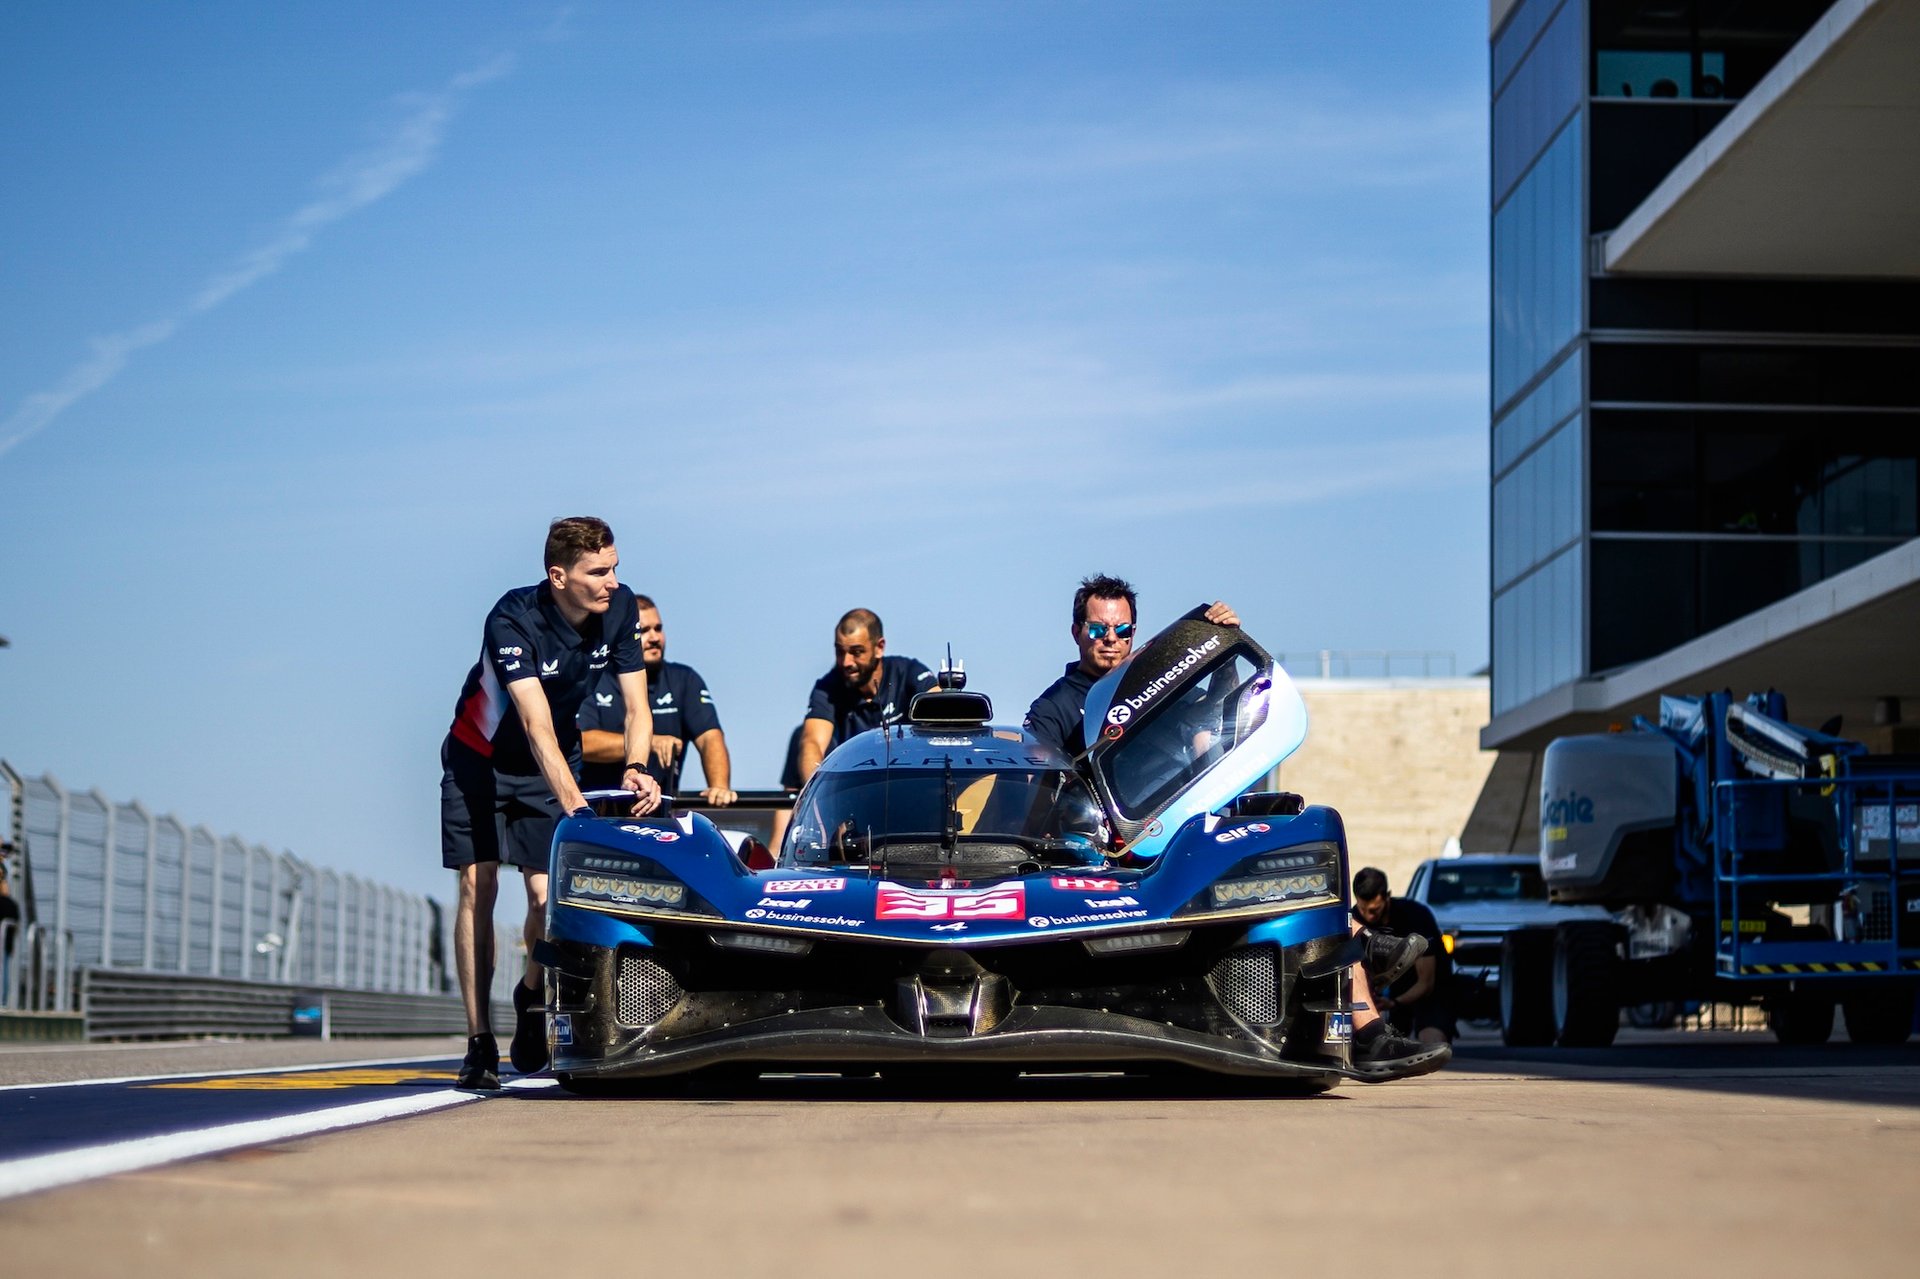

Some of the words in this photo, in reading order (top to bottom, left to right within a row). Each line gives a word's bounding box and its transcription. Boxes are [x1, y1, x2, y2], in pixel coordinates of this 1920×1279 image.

[1125, 634, 1221, 710] businessolver
[852, 756, 1051, 768] ALPINE
[620, 825, 660, 836] elf
[1215, 825, 1249, 843] elf
[770, 883, 838, 891] CAR
[881, 890, 1020, 917] 35
[766, 910, 865, 927] businessolver
[1049, 909, 1148, 925] businessolver
